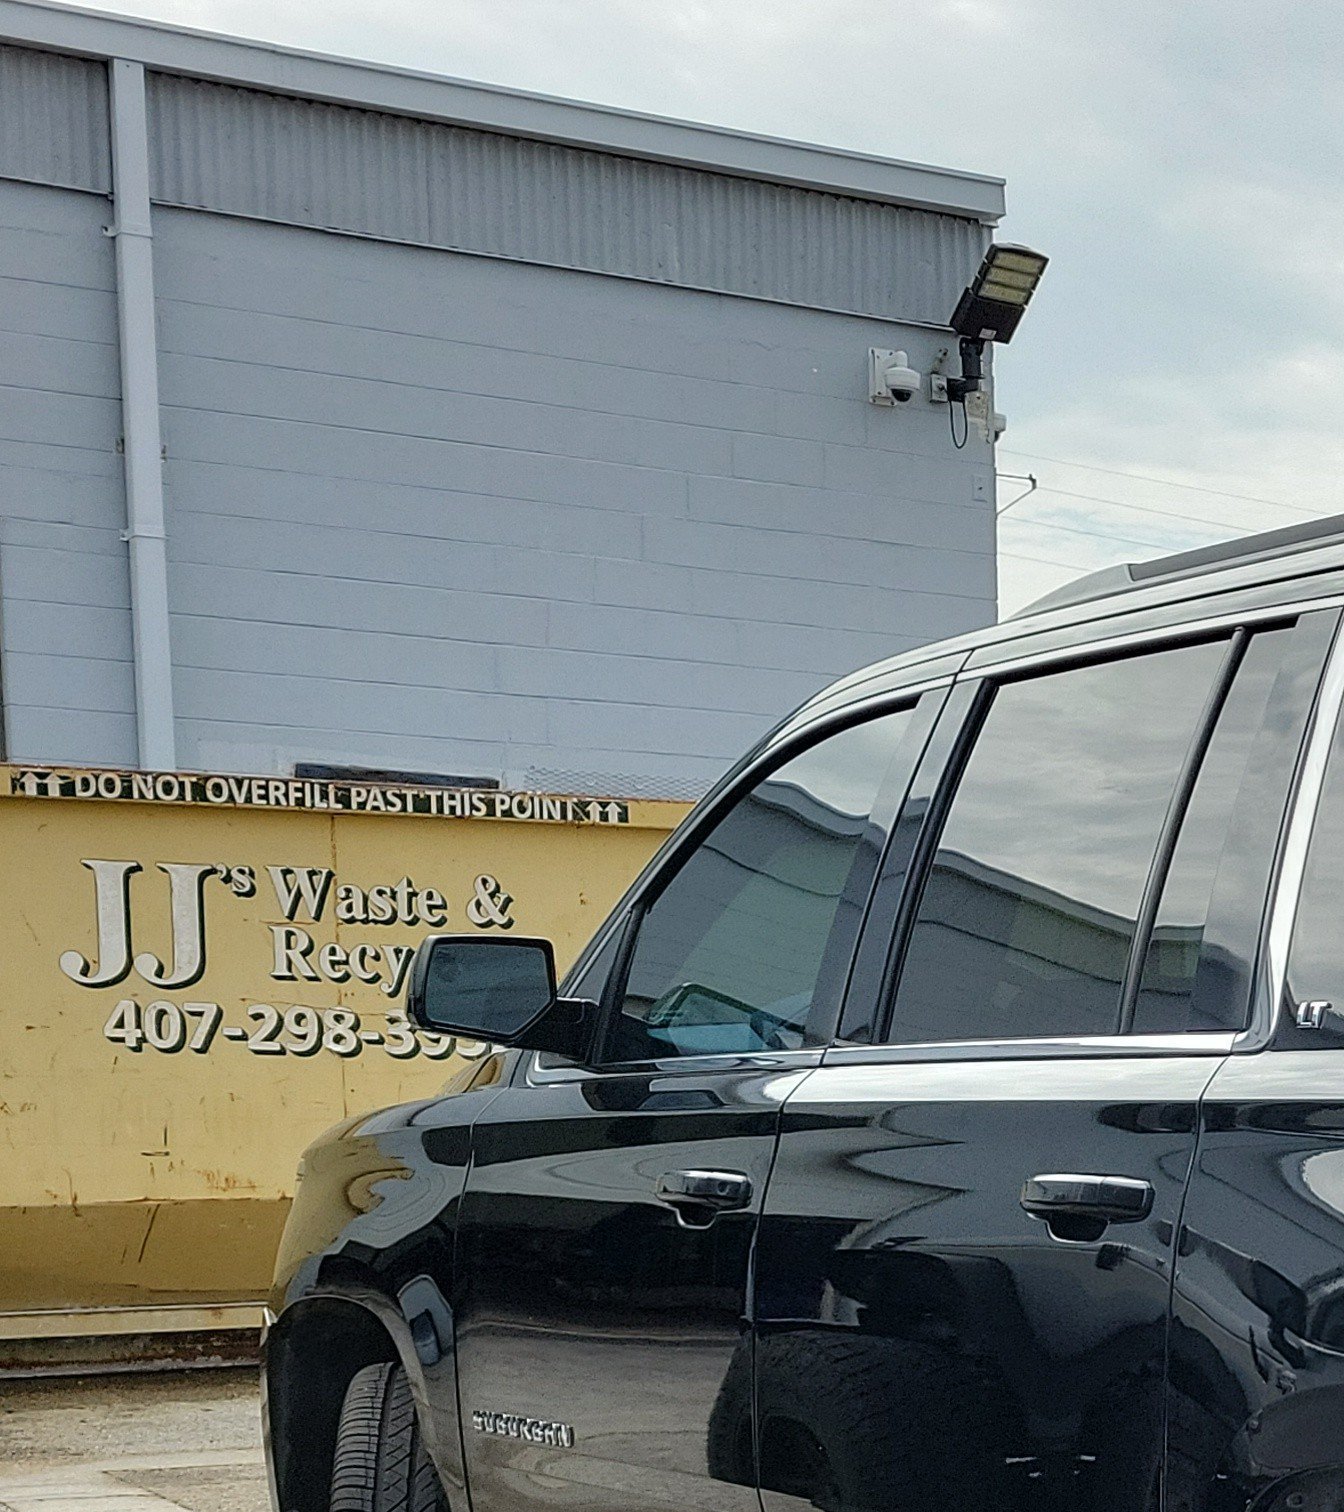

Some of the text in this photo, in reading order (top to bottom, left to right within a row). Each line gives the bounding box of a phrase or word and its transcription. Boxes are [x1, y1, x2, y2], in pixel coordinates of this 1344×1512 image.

[74, 773, 577, 821] DO NOT OVERFILL PAST THIS POINT
[264, 865, 448, 928] Waste
[466, 873, 515, 929] &
[1296, 1001, 1328, 1029] LT
